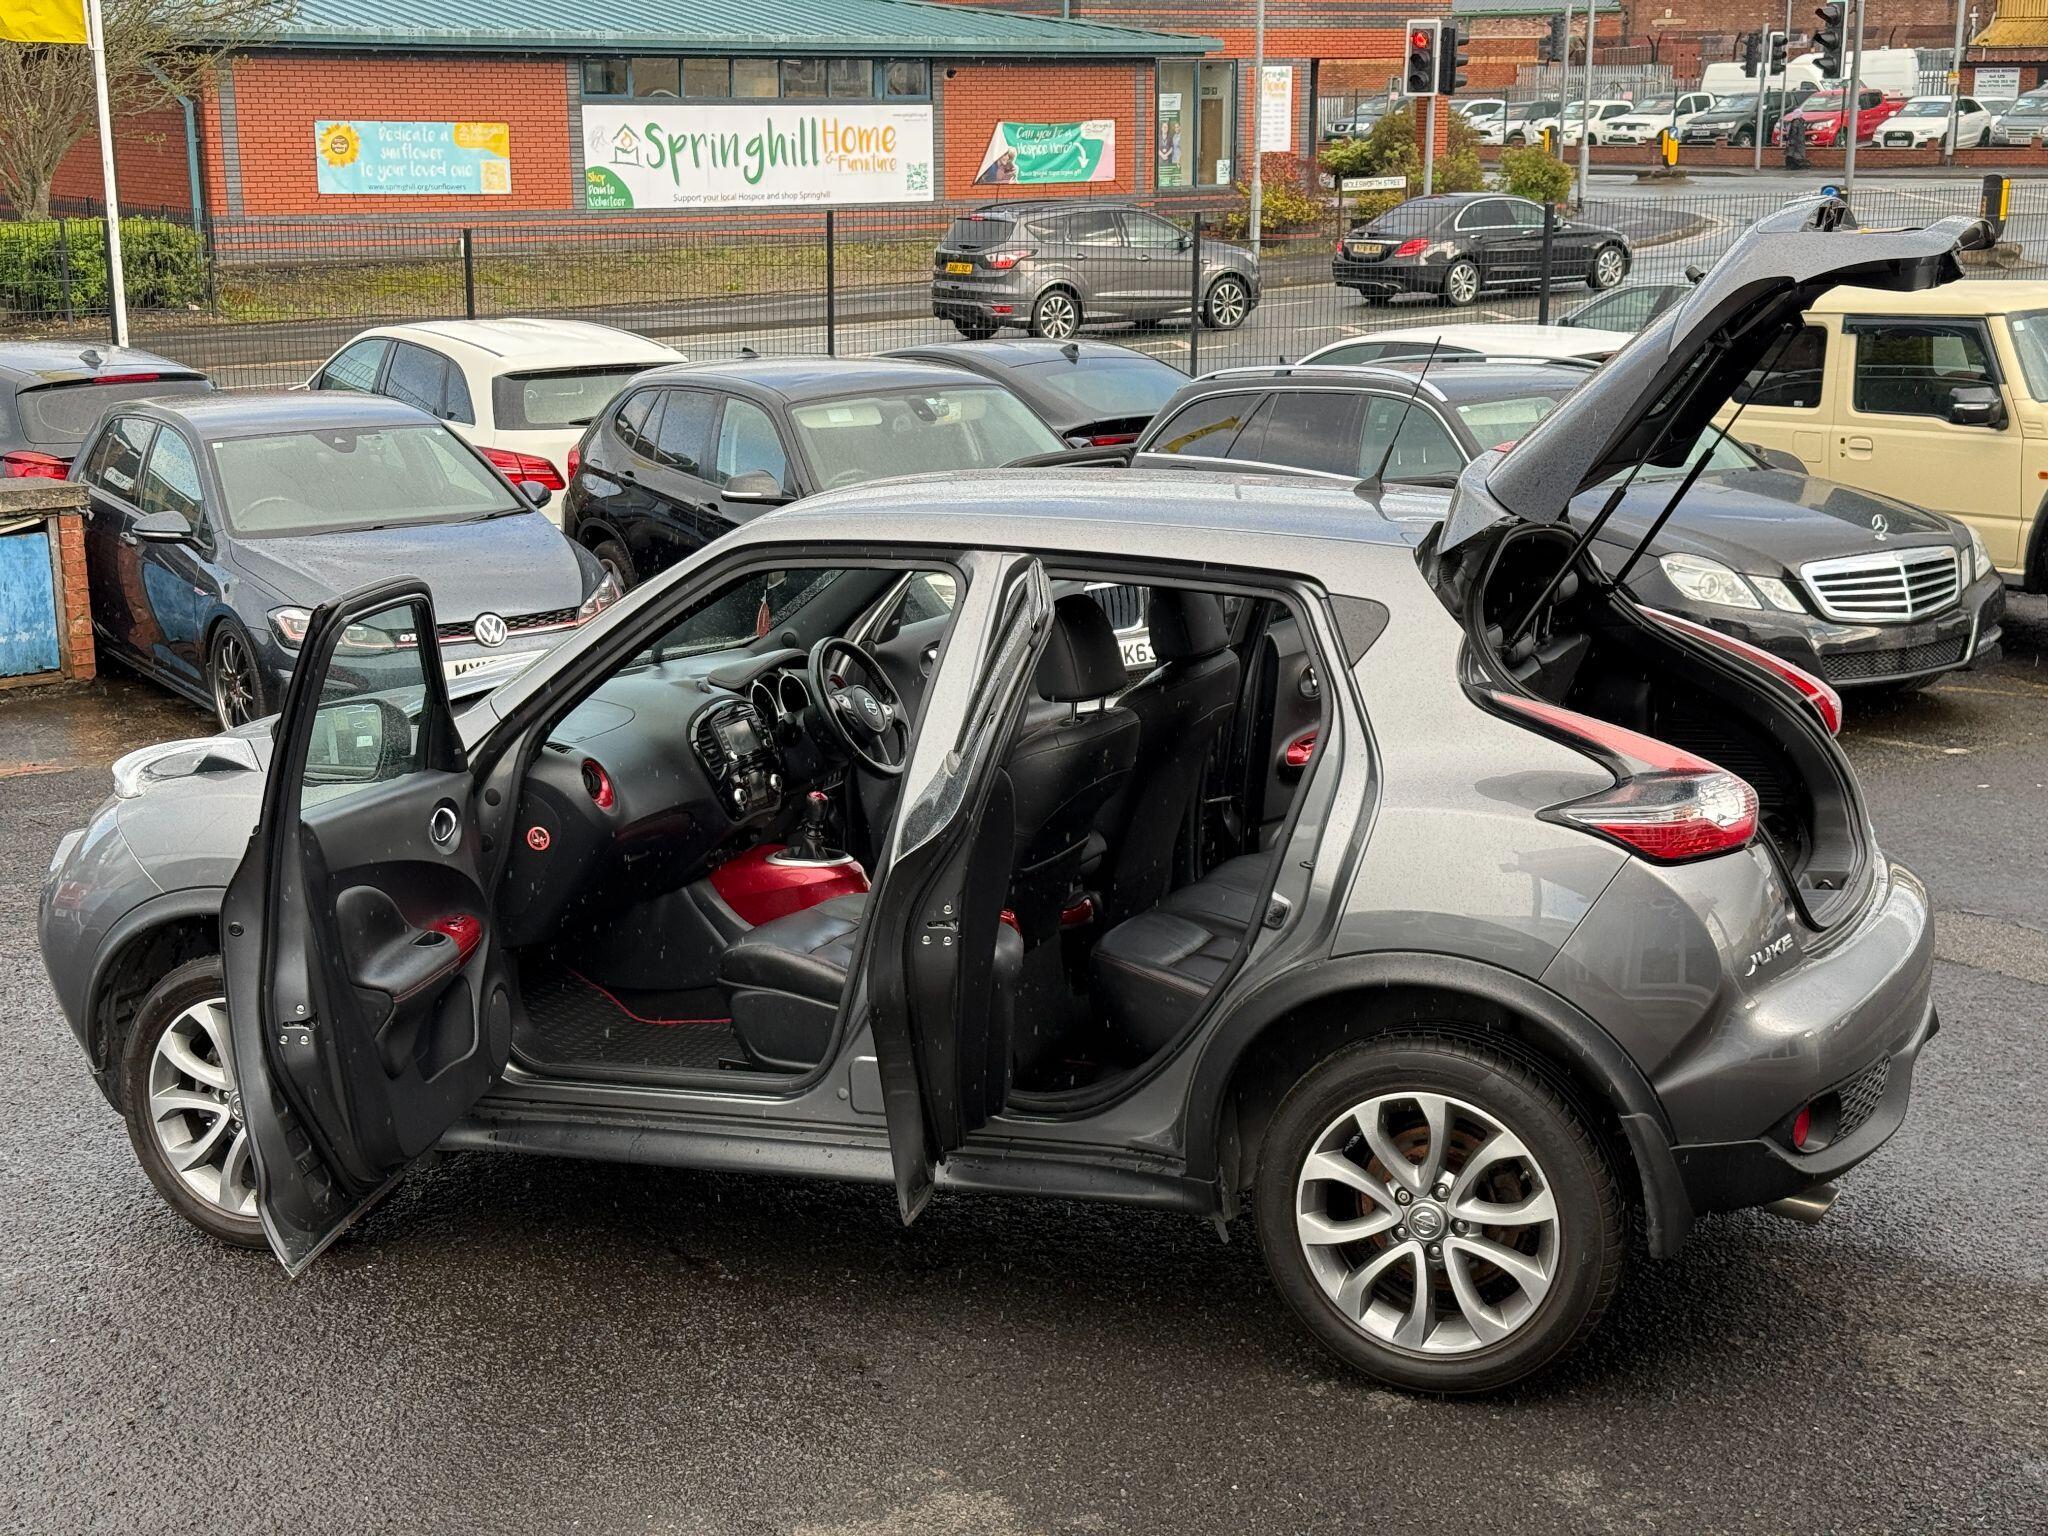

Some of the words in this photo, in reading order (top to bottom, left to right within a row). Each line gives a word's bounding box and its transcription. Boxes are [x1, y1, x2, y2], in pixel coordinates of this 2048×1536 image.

[378, 125, 436, 142] Dedicate
[440, 130, 449, 141] a
[1016, 126, 1034, 139] Can
[1034, 130, 1052, 143] you
[380, 142, 445, 160] sunflower
[644, 116, 819, 187] Springhill
[822, 117, 897, 155] Home
[1016, 142, 1048, 159] Hospice
[837, 152, 898, 174] Furniture
[361, 161, 374, 177] to
[377, 164, 407, 183] your
[410, 161, 446, 177] loved
[450, 164, 473, 177] one
[587, 171, 606, 186] Shop
[588, 183, 615, 195] Donate
[1383, 178, 1404, 187] STREET
[588, 196, 626, 207] Volunteer
[673, 193, 702, 203] Support
[703, 194, 719, 203] your
[720, 192, 737, 201] local
[738, 192, 765, 202] Hospice
[767, 191, 780, 200] and
[781, 191, 798, 202] shop
[799, 190, 831, 201] Springhill
[1744, 933, 1795, 977] JUKE
